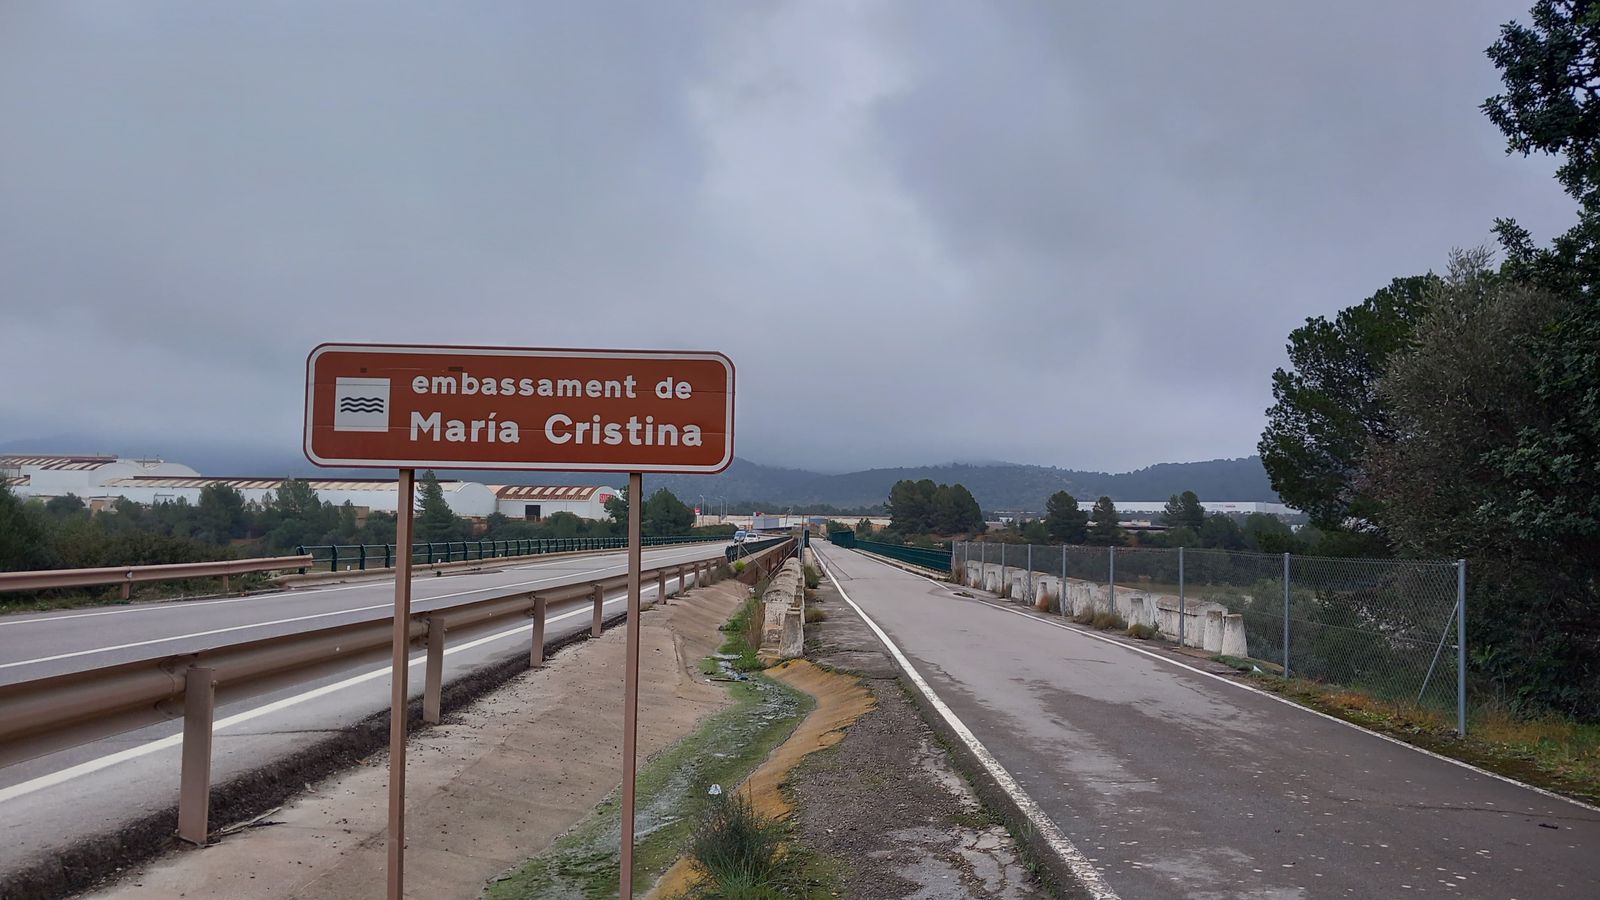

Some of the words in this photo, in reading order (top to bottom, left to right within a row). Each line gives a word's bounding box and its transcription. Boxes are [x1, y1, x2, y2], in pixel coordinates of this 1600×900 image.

[412, 372, 637, 399] embassament
[655, 376, 692, 400] de
[410, 411, 520, 443] María
[544, 413, 703, 447] Cristina
